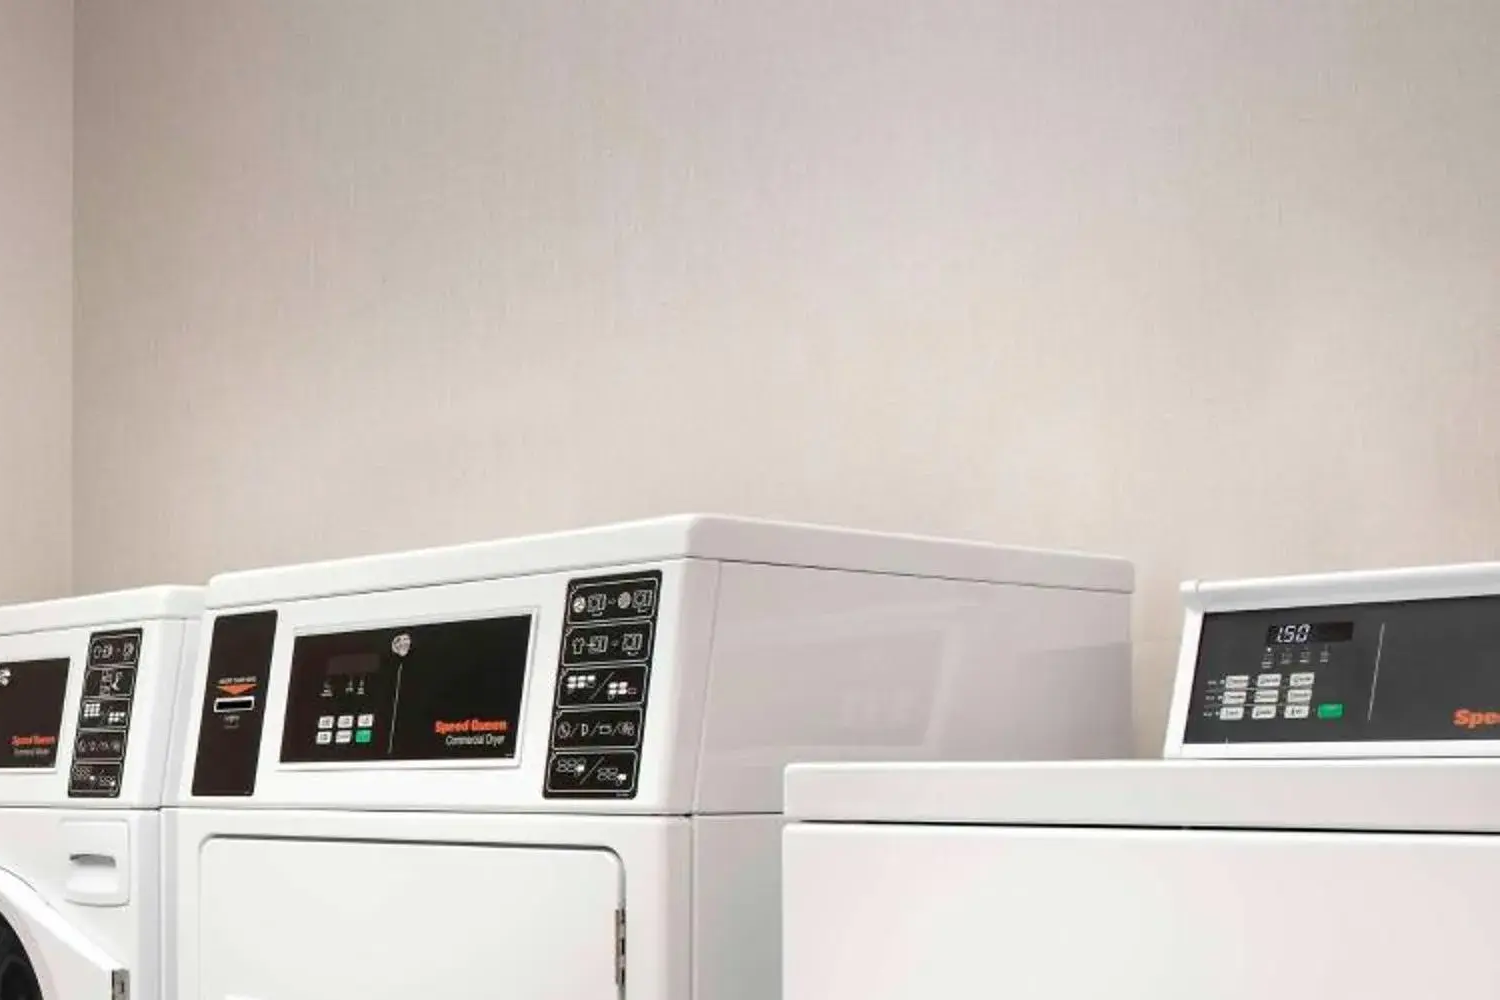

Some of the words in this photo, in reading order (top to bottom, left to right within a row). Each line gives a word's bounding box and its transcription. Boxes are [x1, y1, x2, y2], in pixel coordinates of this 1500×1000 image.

[435, 720, 469, 734] Speed
[472, 719, 507, 732] Queen
[1452, 709, 1500, 729] Spe
[445, 735, 484, 746] Commercial
[486, 733, 506, 748] Dryer
